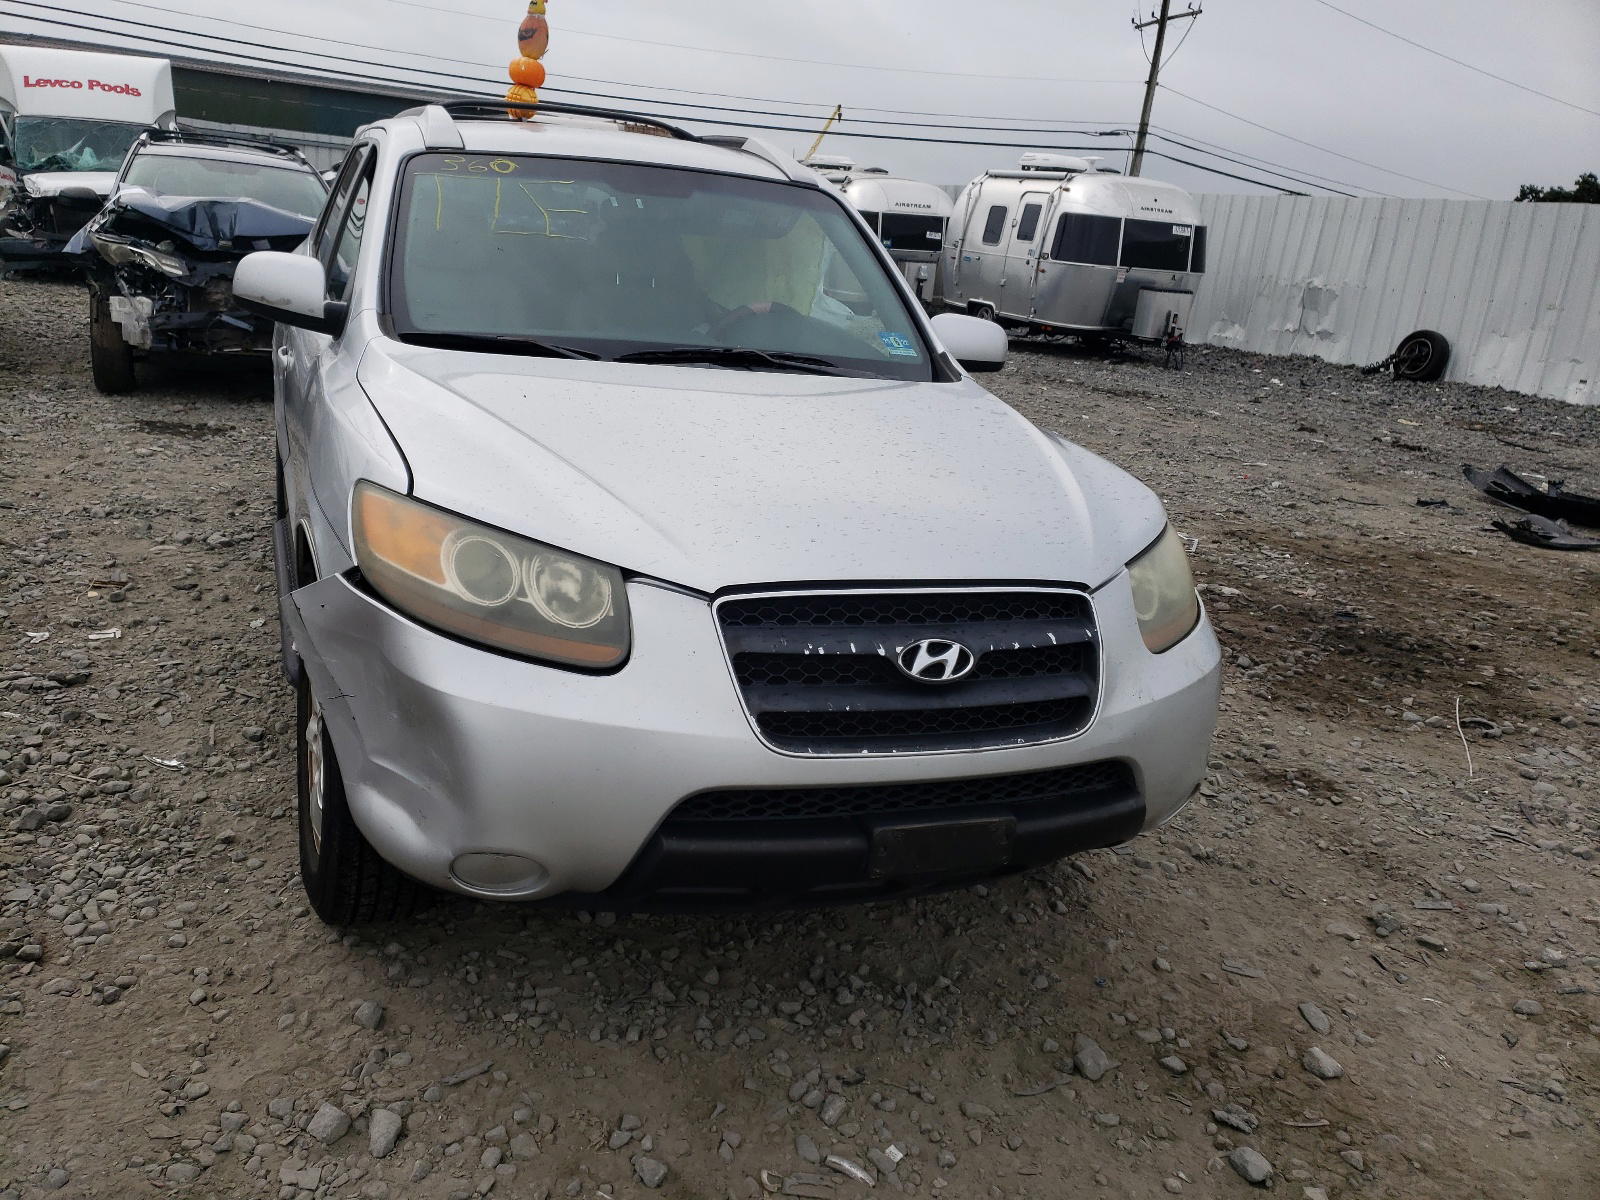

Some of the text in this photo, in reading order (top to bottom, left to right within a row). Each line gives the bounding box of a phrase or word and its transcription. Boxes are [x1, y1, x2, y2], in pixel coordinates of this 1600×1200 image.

[23, 75, 142, 97] Levco Pools
[440, 155, 520, 174] 360
[1140, 206, 1173, 214] AIRSTREAM
